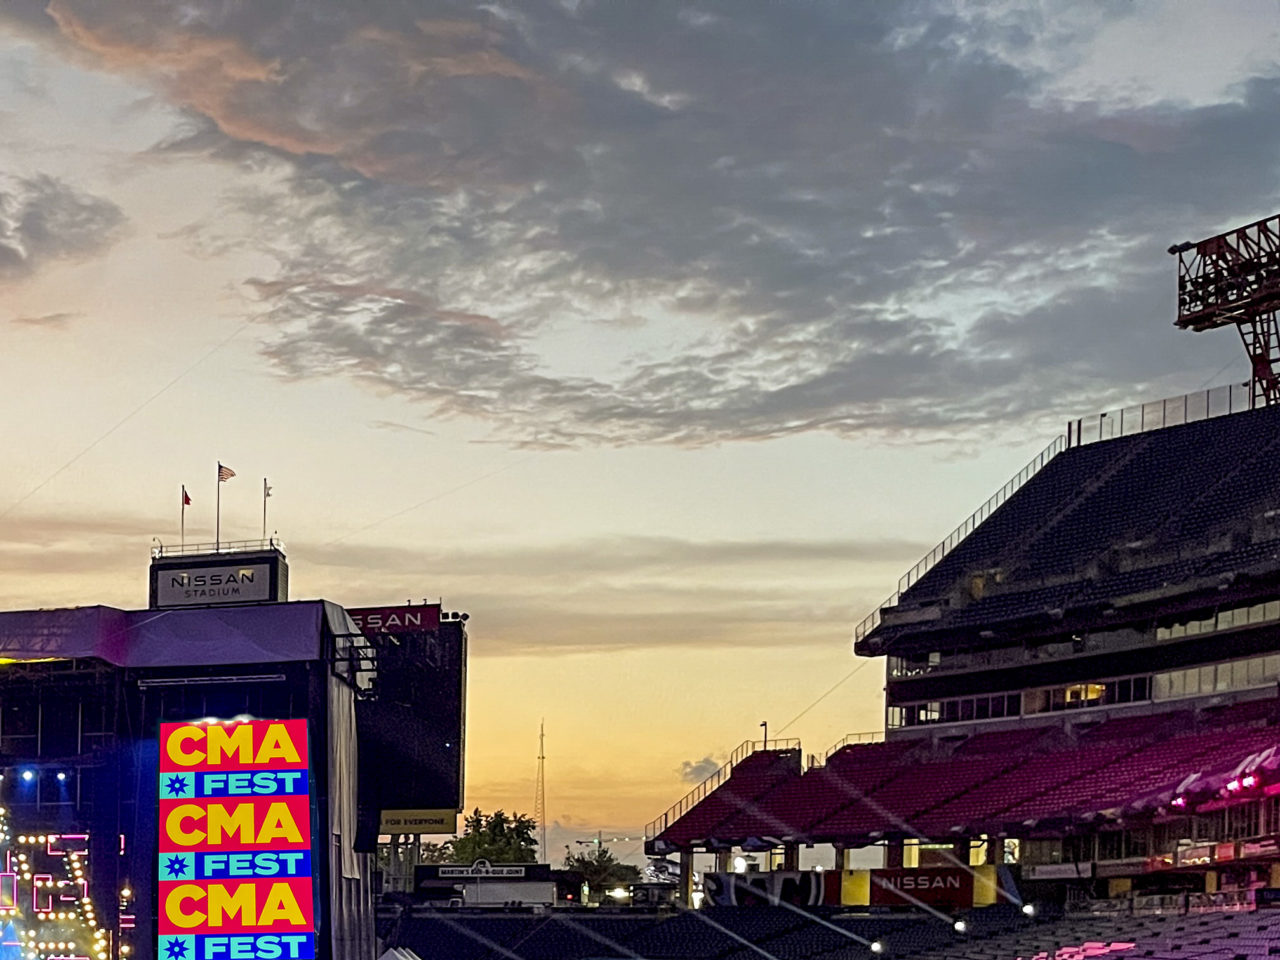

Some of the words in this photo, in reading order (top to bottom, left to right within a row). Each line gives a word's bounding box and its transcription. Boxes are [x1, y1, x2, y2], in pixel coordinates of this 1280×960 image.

[171, 573, 254, 588] NISSAN
[184, 587, 241, 598] STADIUM
[351, 613, 421, 628] SSAN
[166, 723, 302, 766] CMA
[203, 772, 302, 795] FEST
[165, 802, 304, 846] CMA
[204, 852, 304, 876] FEST
[881, 876, 960, 889] NISSAN
[165, 882, 307, 928] CMA
[204, 935, 307, 960] FEST
